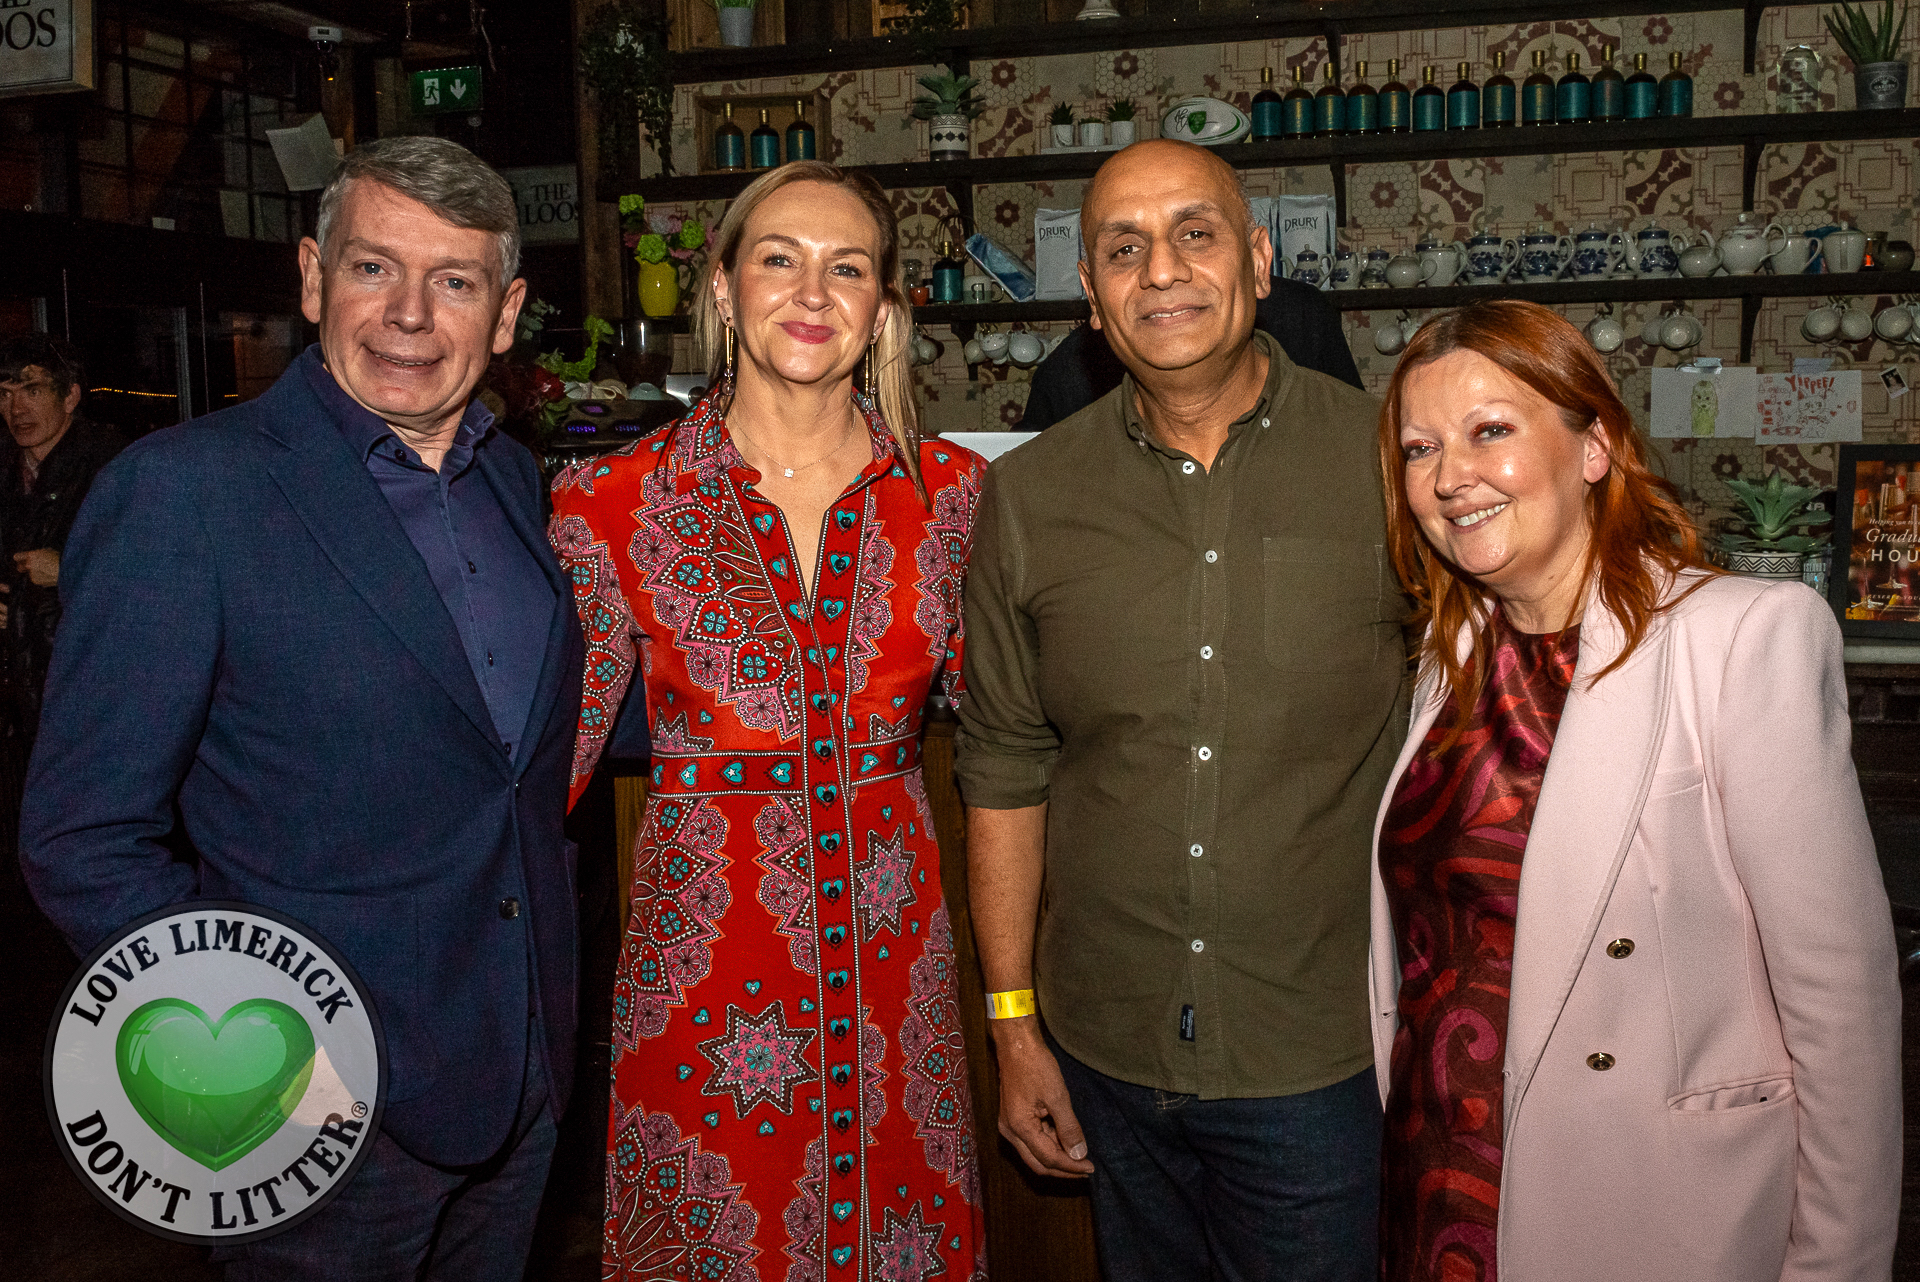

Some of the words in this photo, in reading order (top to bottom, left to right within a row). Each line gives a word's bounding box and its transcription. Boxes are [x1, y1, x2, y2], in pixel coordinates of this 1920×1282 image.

[0, 8, 57, 51] OS
[530, 183, 571, 201] THE
[1284, 216, 1319, 233] DRURY
[1039, 225, 1072, 242] DRURY
[1784, 374, 1835, 395] YIPPEE!
[1866, 527, 1920, 543] Gradu
[1871, 548, 1919, 563] HOU
